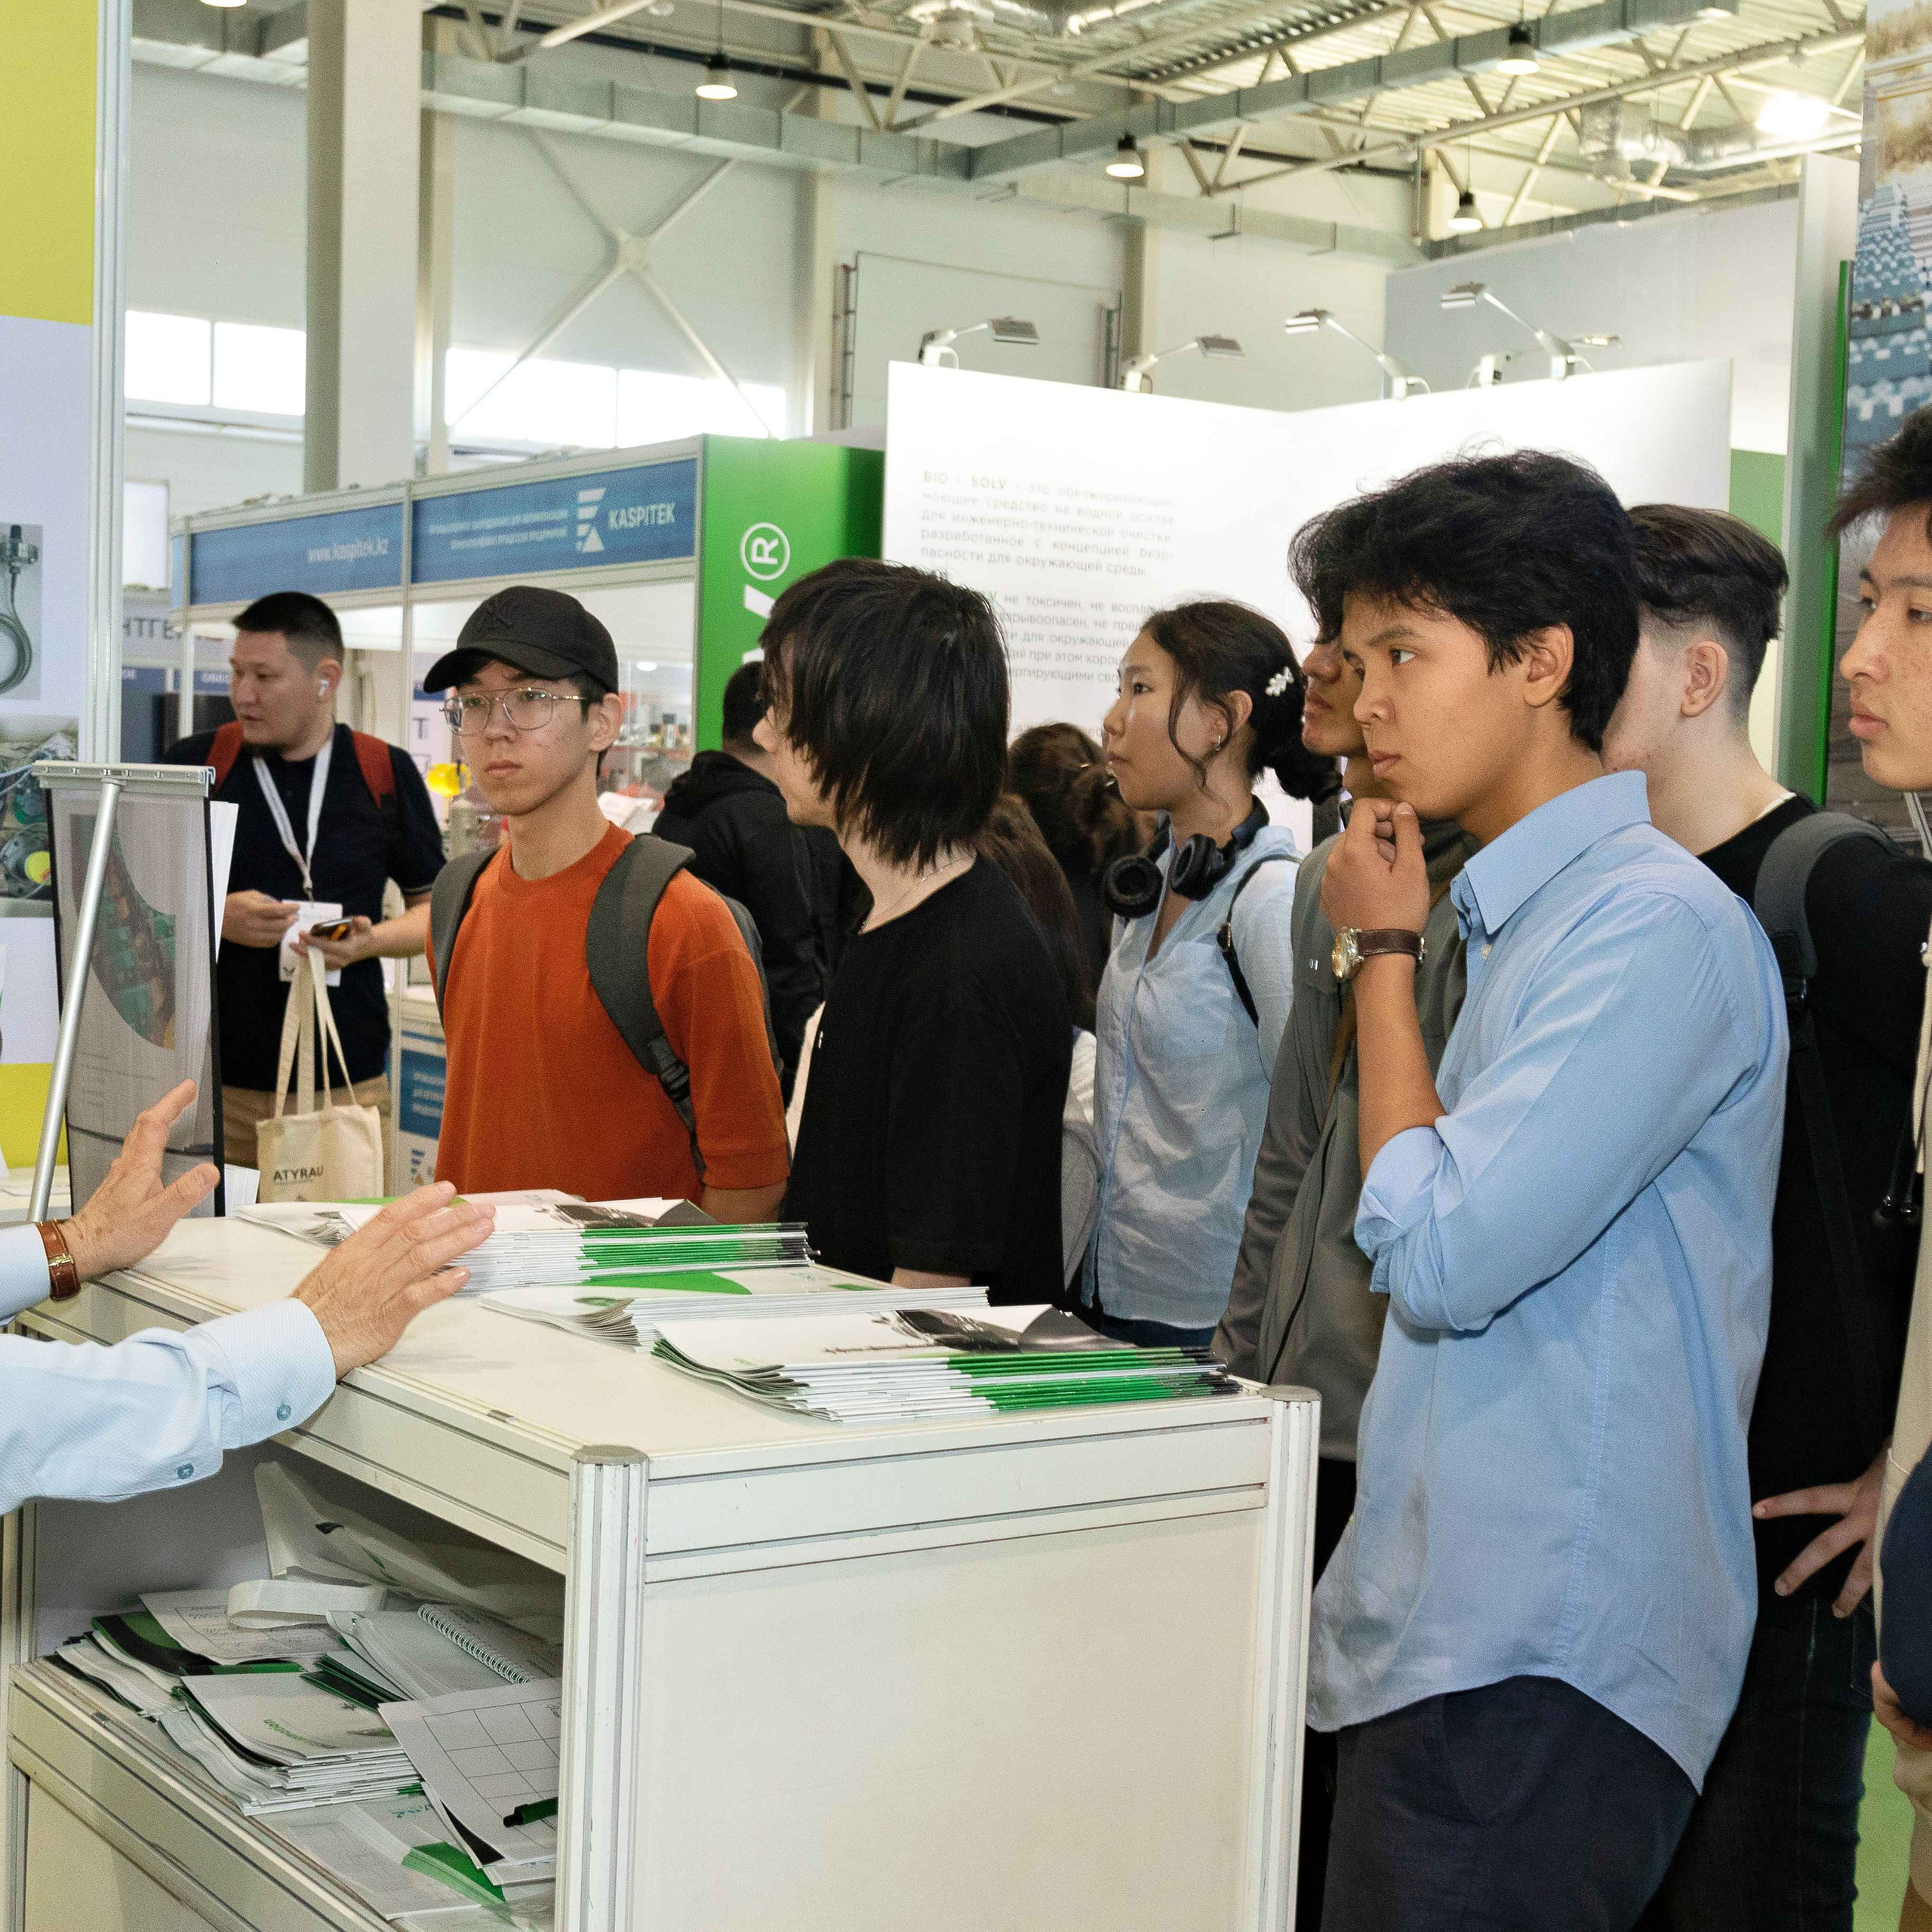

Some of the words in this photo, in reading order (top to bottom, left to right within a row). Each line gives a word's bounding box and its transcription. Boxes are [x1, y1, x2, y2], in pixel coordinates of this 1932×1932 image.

[923, 471, 949, 485] BIO
[971, 475, 1008, 491] SOLV
[608, 503, 677, 530] KASPITEK
[921, 509, 946, 522] для
[987, 497, 1048, 515] средство
[1055, 504, 1070, 515] на
[1077, 505, 1124, 521] водной
[921, 528, 1025, 549] разработанное
[1052, 540, 1130, 558] концепцией
[921, 546, 984, 562] пасности
[988, 552, 1012, 565] для
[1017, 555, 1103, 574] окружающей
[1004, 595, 1020, 605] не
[1091, 601, 1106, 612] не
[1093, 618, 1109, 629] не
[1023, 632, 1044, 643] для
[1030, 651, 1052, 663] при
[1055, 653, 1083, 665] этом
[273, 1164, 324, 1182] ATYRAU
